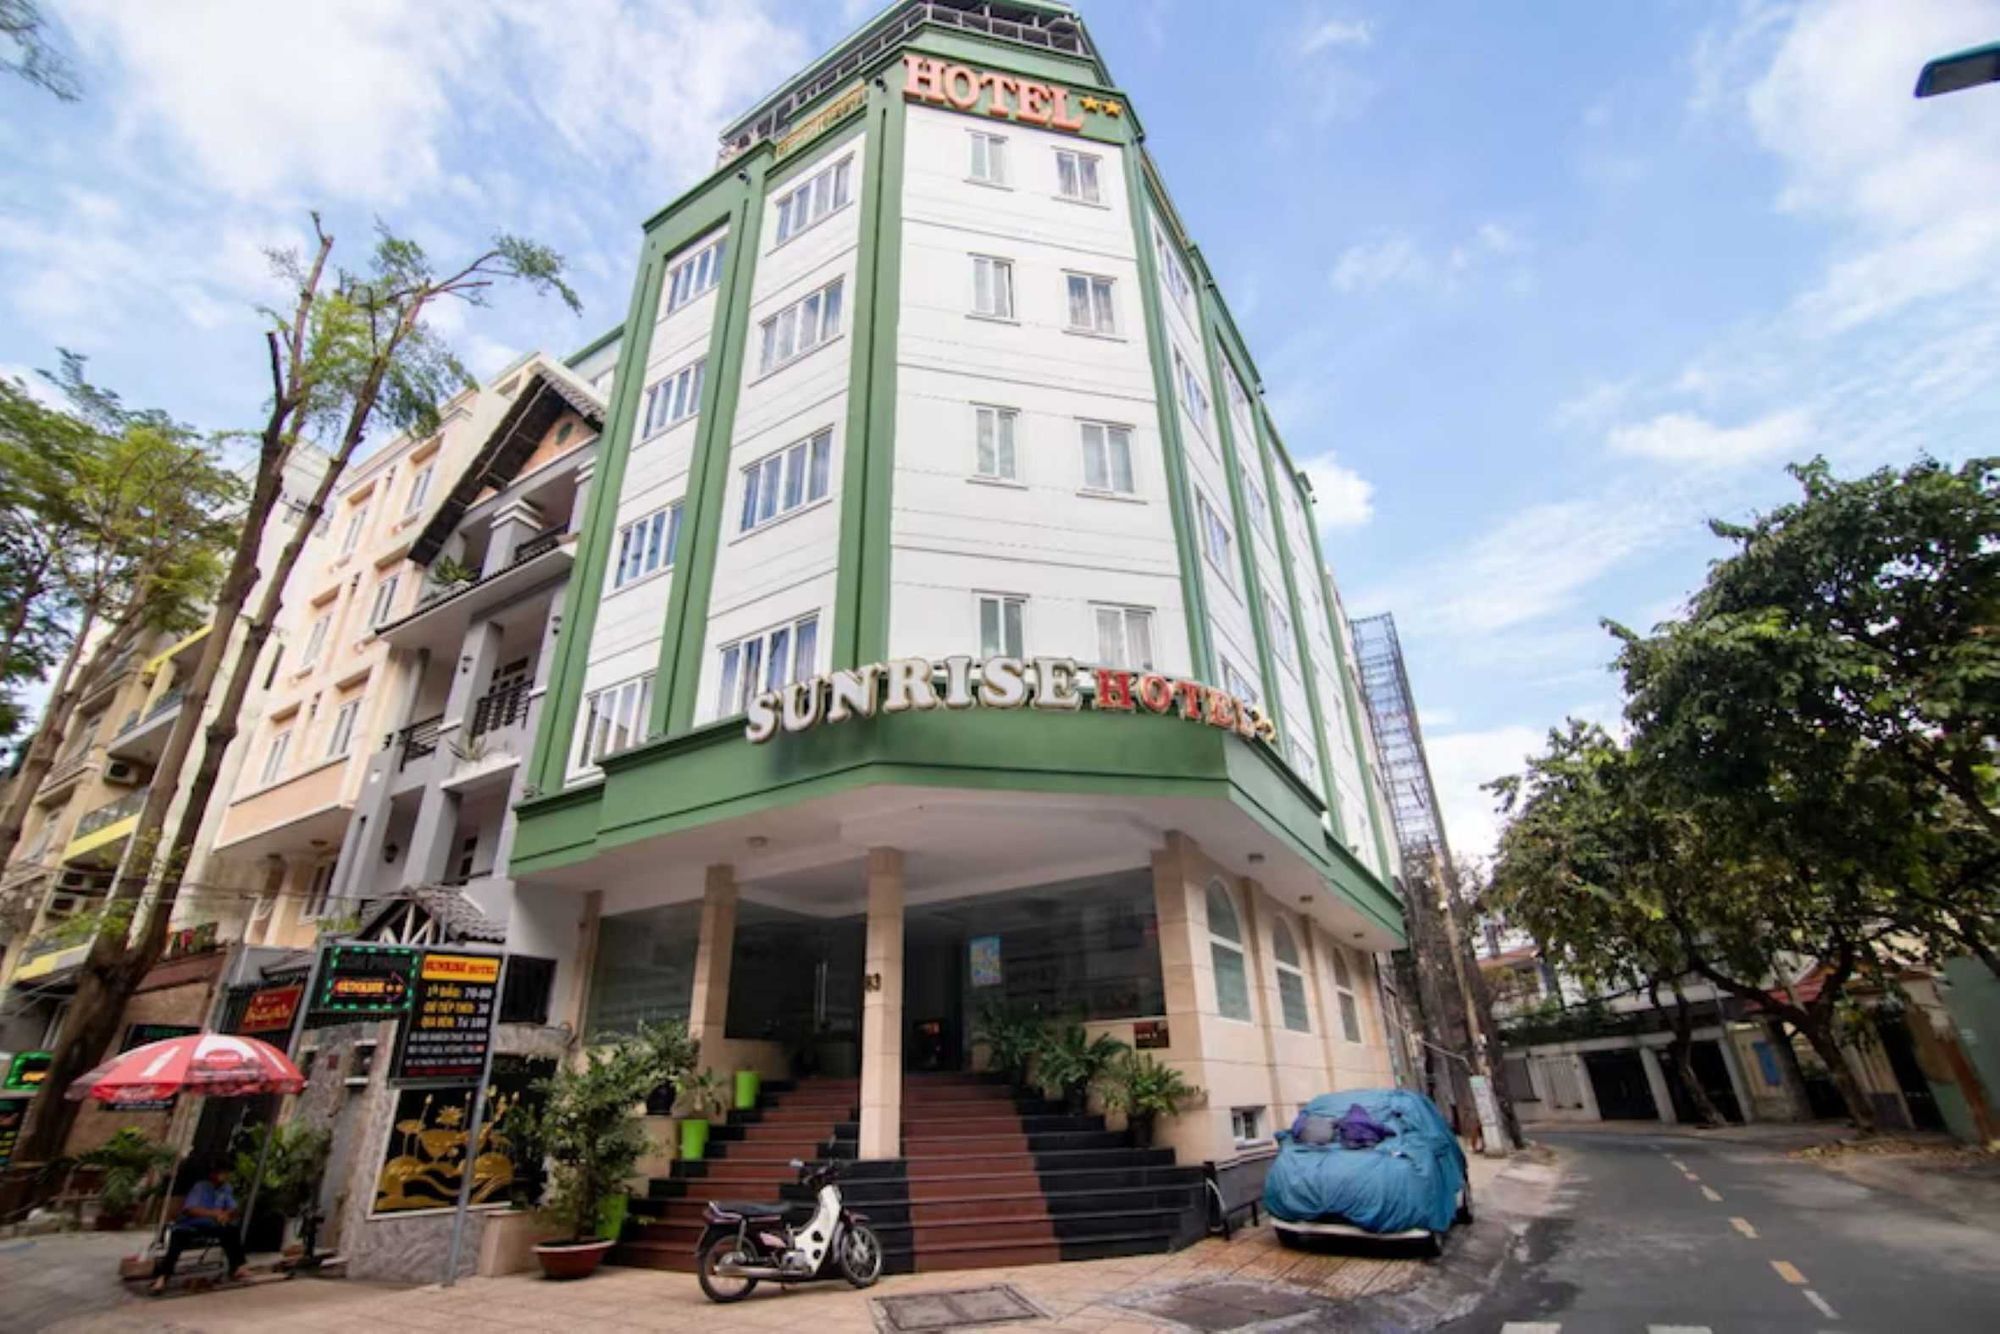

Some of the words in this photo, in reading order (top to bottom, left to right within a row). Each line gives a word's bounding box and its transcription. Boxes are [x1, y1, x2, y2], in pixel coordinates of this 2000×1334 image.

[903, 54, 1083, 131] HOTEL
[745, 655, 1083, 743] SUNRISE
[1092, 667, 1256, 739] HOTEL
